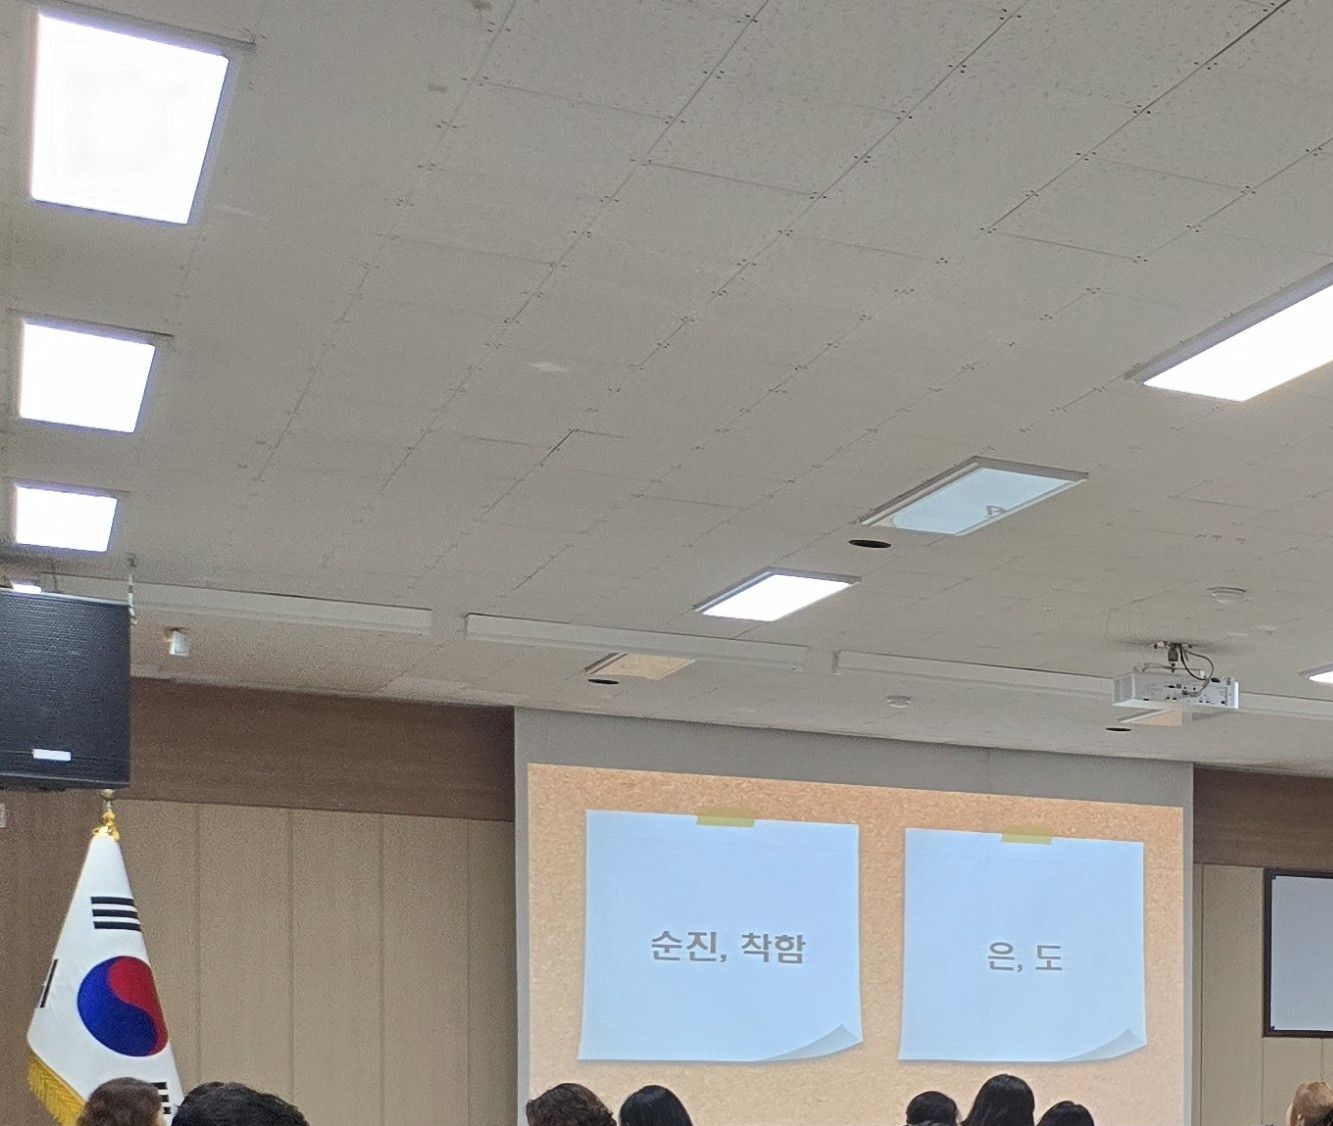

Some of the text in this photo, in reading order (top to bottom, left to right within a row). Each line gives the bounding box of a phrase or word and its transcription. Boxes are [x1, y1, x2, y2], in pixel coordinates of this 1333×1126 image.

[651, 930, 806, 964] 순진, 착함
[987, 942, 1063, 973] 은, 도
